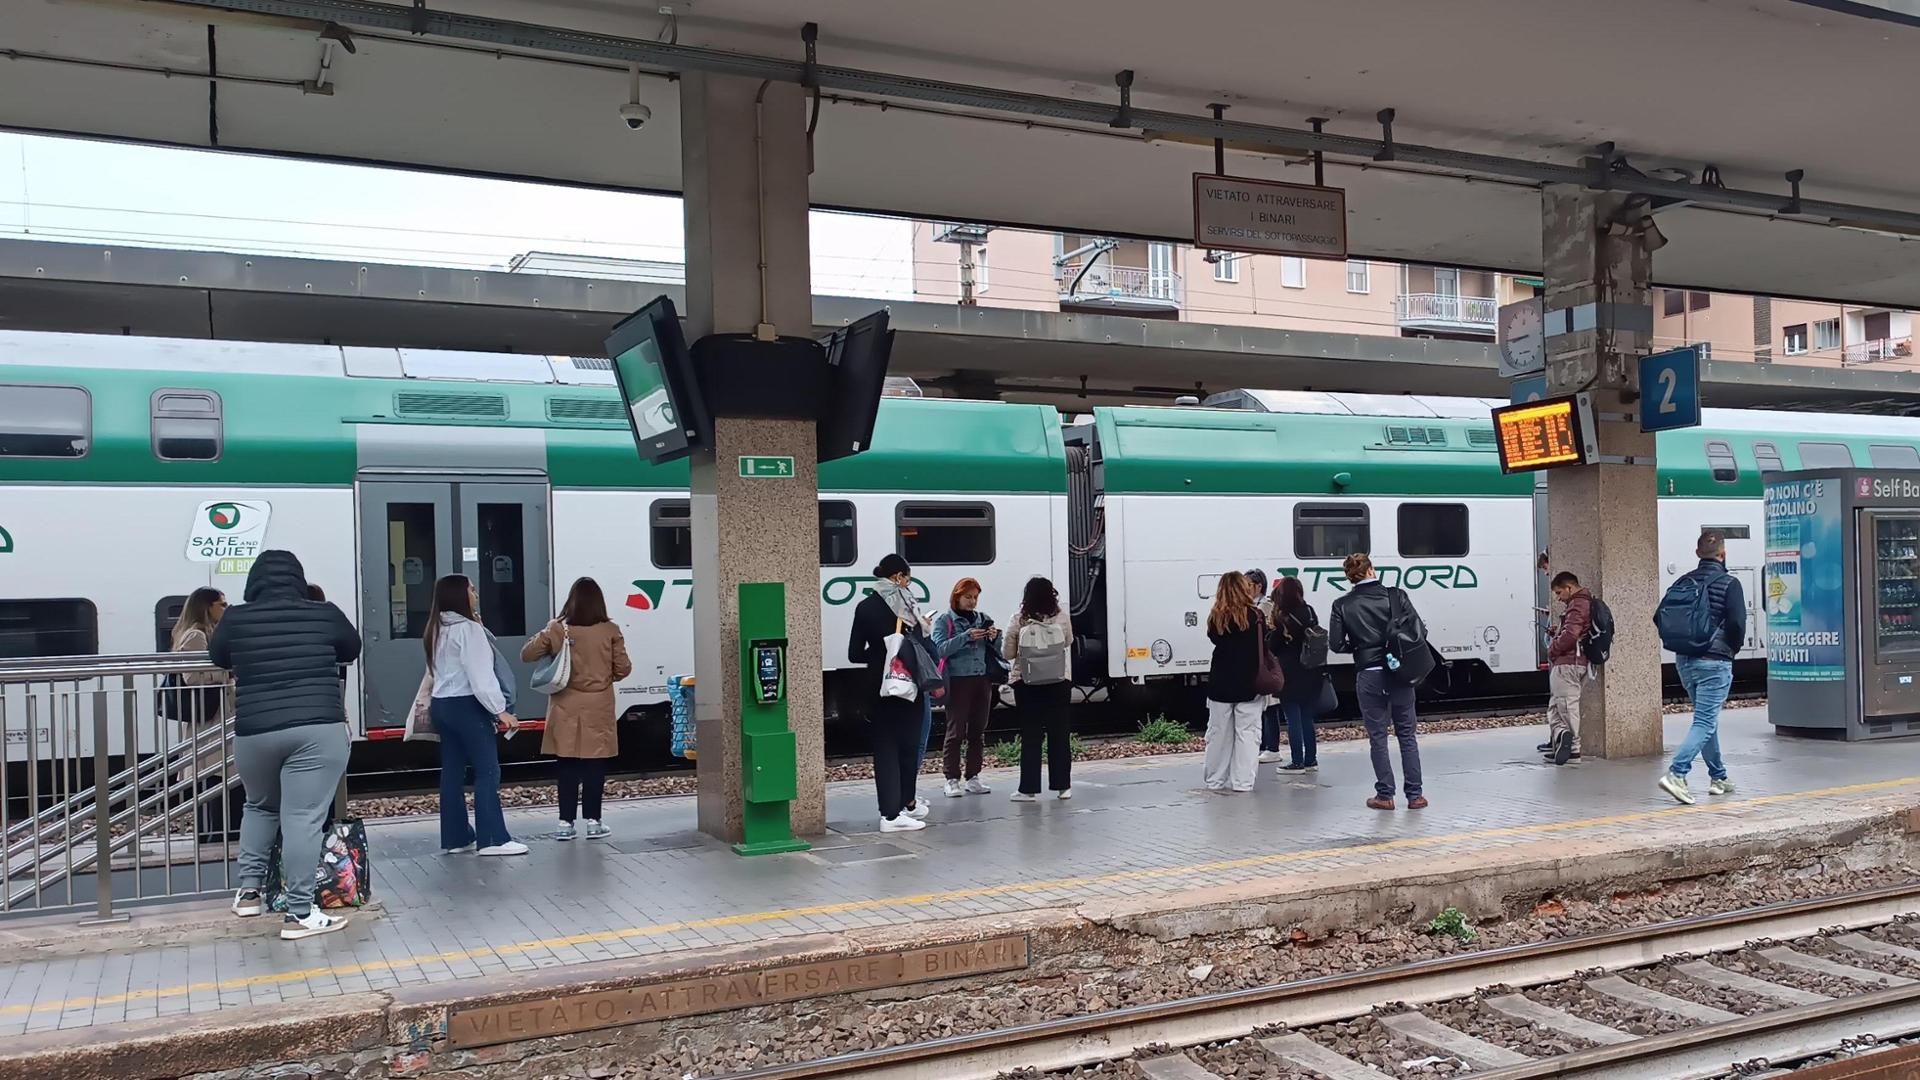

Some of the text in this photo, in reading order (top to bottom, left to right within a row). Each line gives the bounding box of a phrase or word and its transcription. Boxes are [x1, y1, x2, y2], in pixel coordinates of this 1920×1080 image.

[1207, 188, 1337, 211] VIETATO ATTRAVERSARE
[1259, 212, 1296, 225] BINARI
[1207, 225, 1338, 246] SERVIRSI DEL SOTTOPASSAGGIO
[1658, 367, 1677, 414] 2
[1776, 485, 1800, 500] NON
[1873, 478, 1900, 498] Self
[192, 536, 239, 547] SAFE
[200, 547, 257, 558] QUIET
[220, 560, 234, 572] ON
[1303, 565, 1478, 592] TRNORD
[1770, 631, 1840, 646] PROTEGGERE
[1779, 648, 1809, 663] DENTI
[470, 999, 616, 1033] VIETATO
[639, 961, 880, 1014] ATTRAVERSARE
[925, 943, 1018, 973] BINARI
